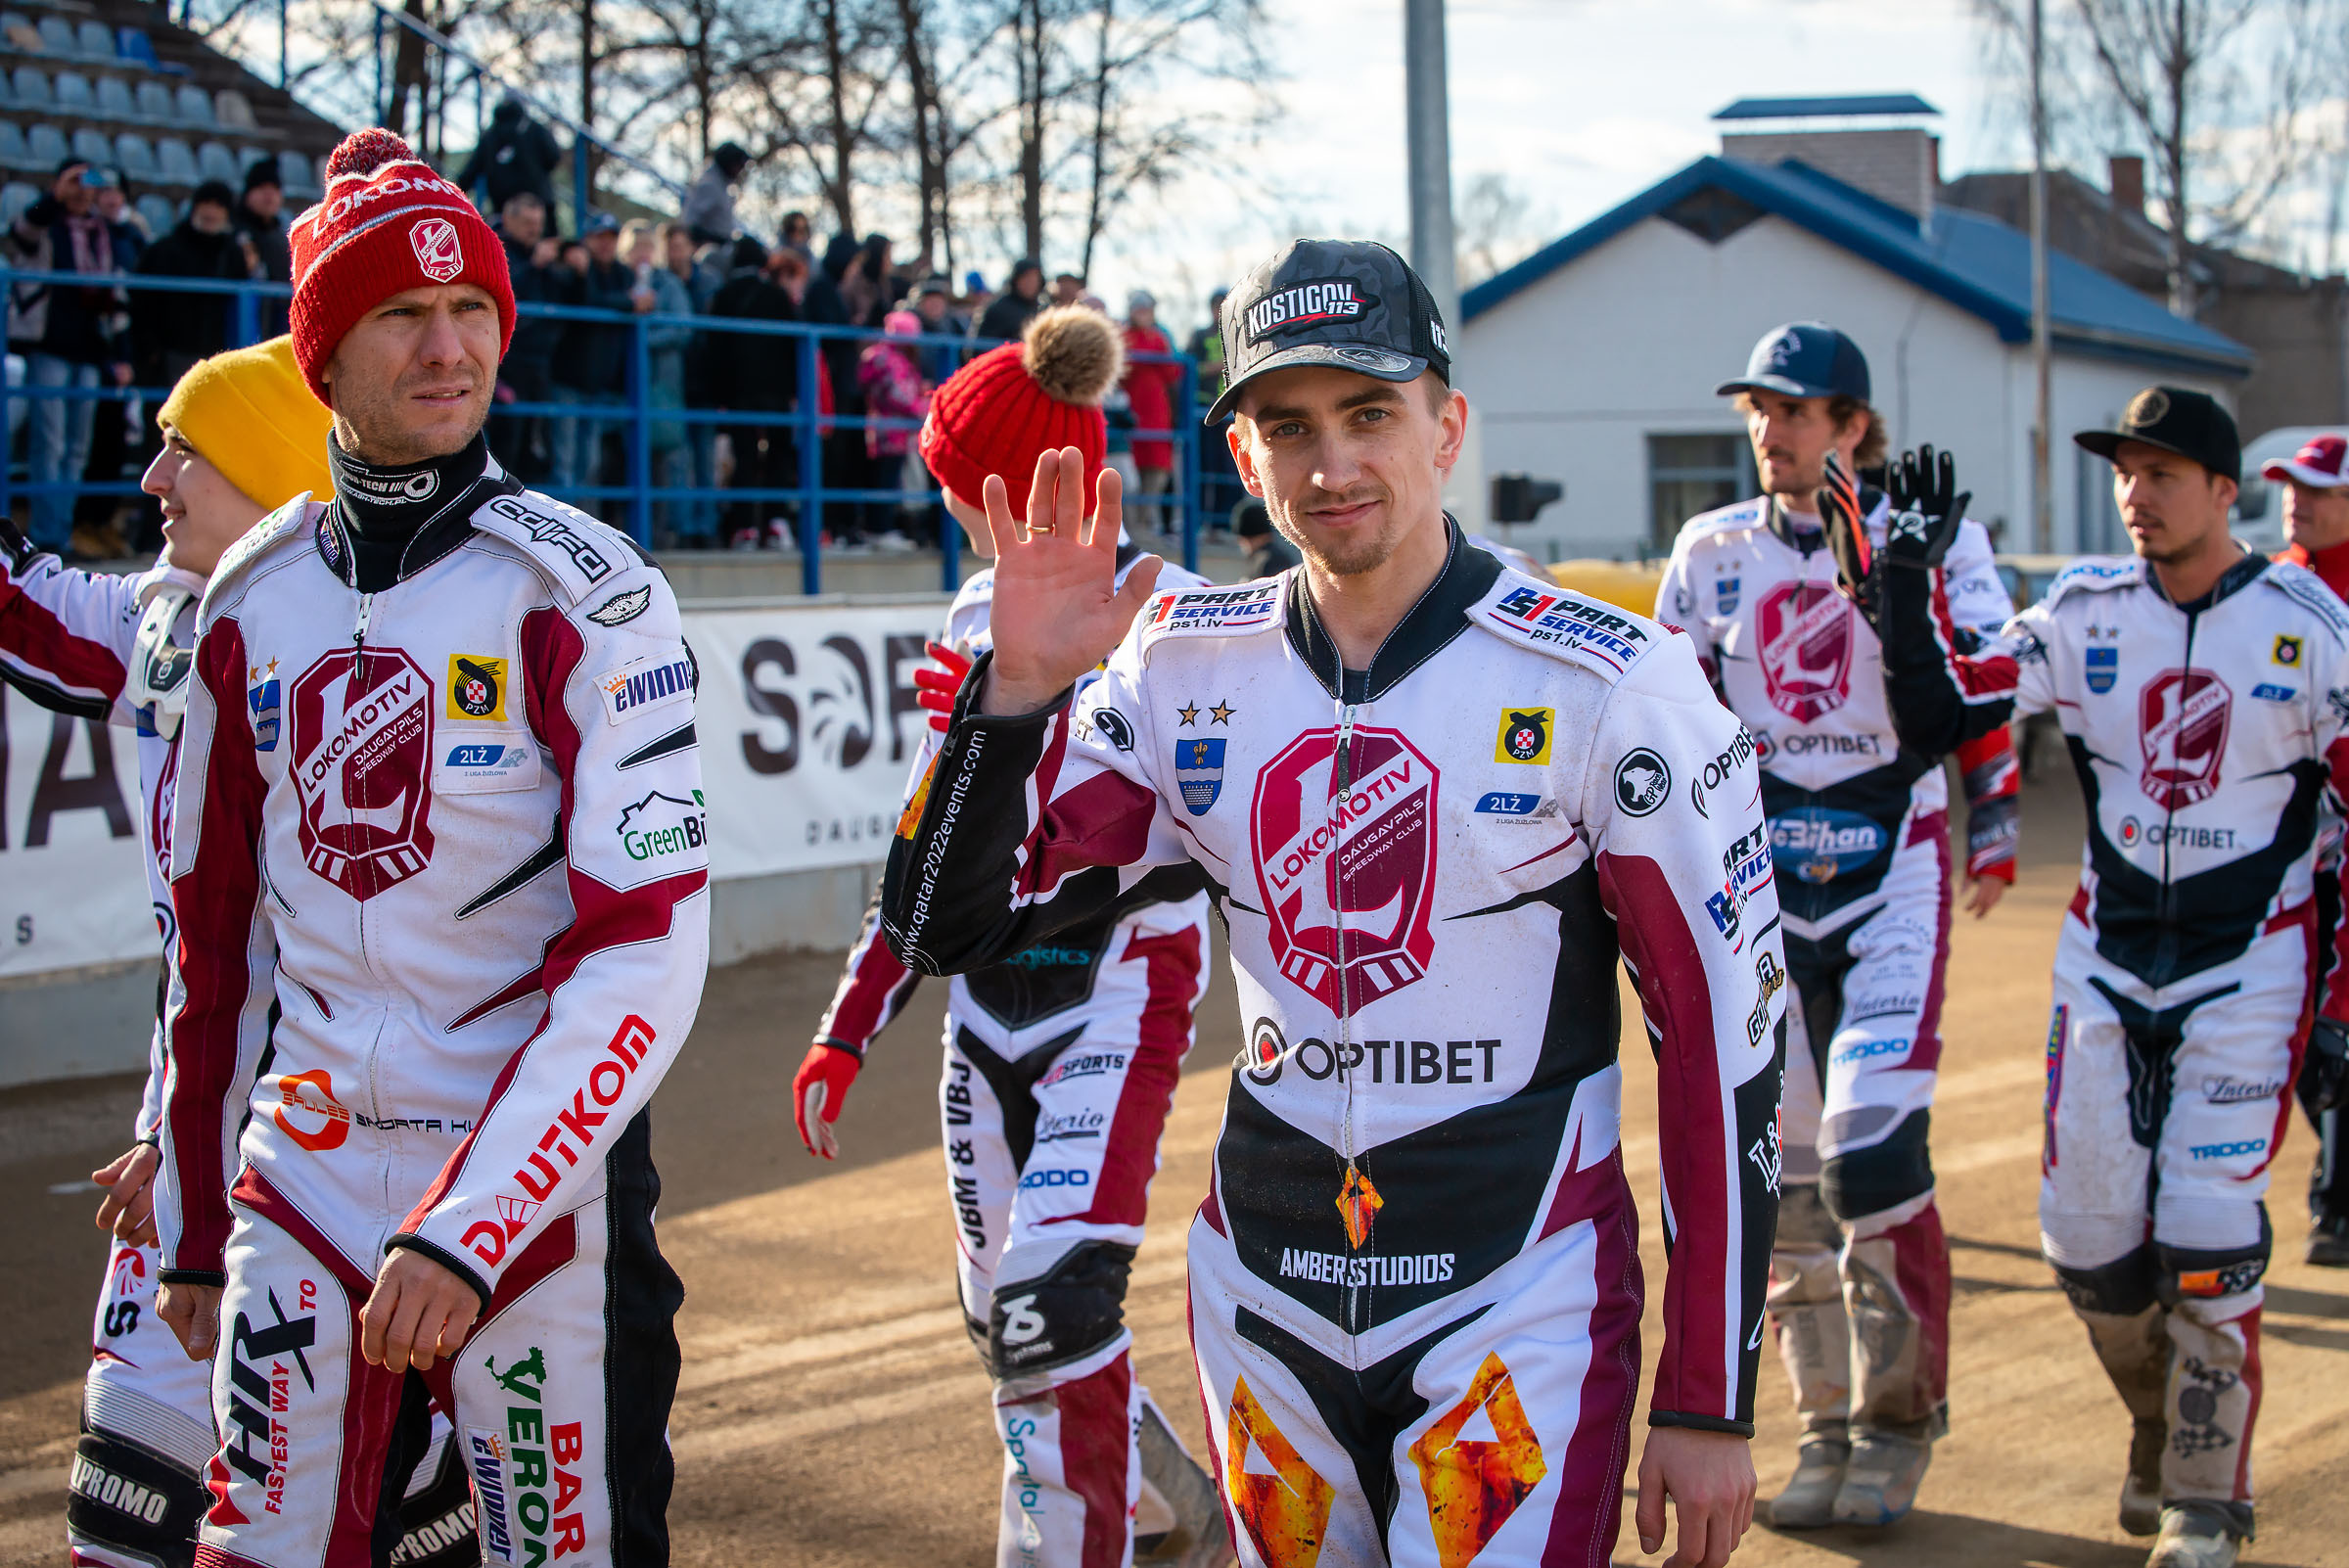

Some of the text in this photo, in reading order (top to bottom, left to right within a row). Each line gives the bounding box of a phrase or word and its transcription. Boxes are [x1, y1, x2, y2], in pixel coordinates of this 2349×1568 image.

[422, 225, 449, 256] LOKOMOTIV
[1327, 301, 1359, 315] 113
[1170, 601, 1274, 620] SERVICE
[1176, 584, 1278, 606] PART
[1170, 618, 1223, 631] ps1.lv
[1530, 628, 1583, 649] ps1.lv
[1538, 615, 1636, 663] SERVICE
[1551, 600, 1648, 642] PART
[465, 703, 490, 715] PZM
[302, 674, 411, 794] LOKOMOTIV
[353, 707, 424, 765] DAUGAVPILS
[353, 724, 423, 780] SPEEDWAY CLUB
[1512, 748, 1535, 759] PZM
[1704, 722, 1756, 790] OPTIBE
[1784, 735, 1880, 755] OPTIBET
[1269, 760, 1410, 891] LOKOMOTIV
[1341, 798, 1424, 866] DAUGAVPILS
[1723, 820, 1764, 878] ART
[2146, 825, 2235, 849] OPTIBET
[901, 730, 987, 969] www.qatar2022events.com
[1343, 818, 1423, 882] SPEEDWAY CLUB
[1295, 1038, 1502, 1084] OPTIBET
[946, 1061, 972, 1125] VBJ
[299, 1279, 317, 1311] TO
[265, 1360, 290, 1515] FASTEST WAY
[550, 1421, 586, 1560] BAR
